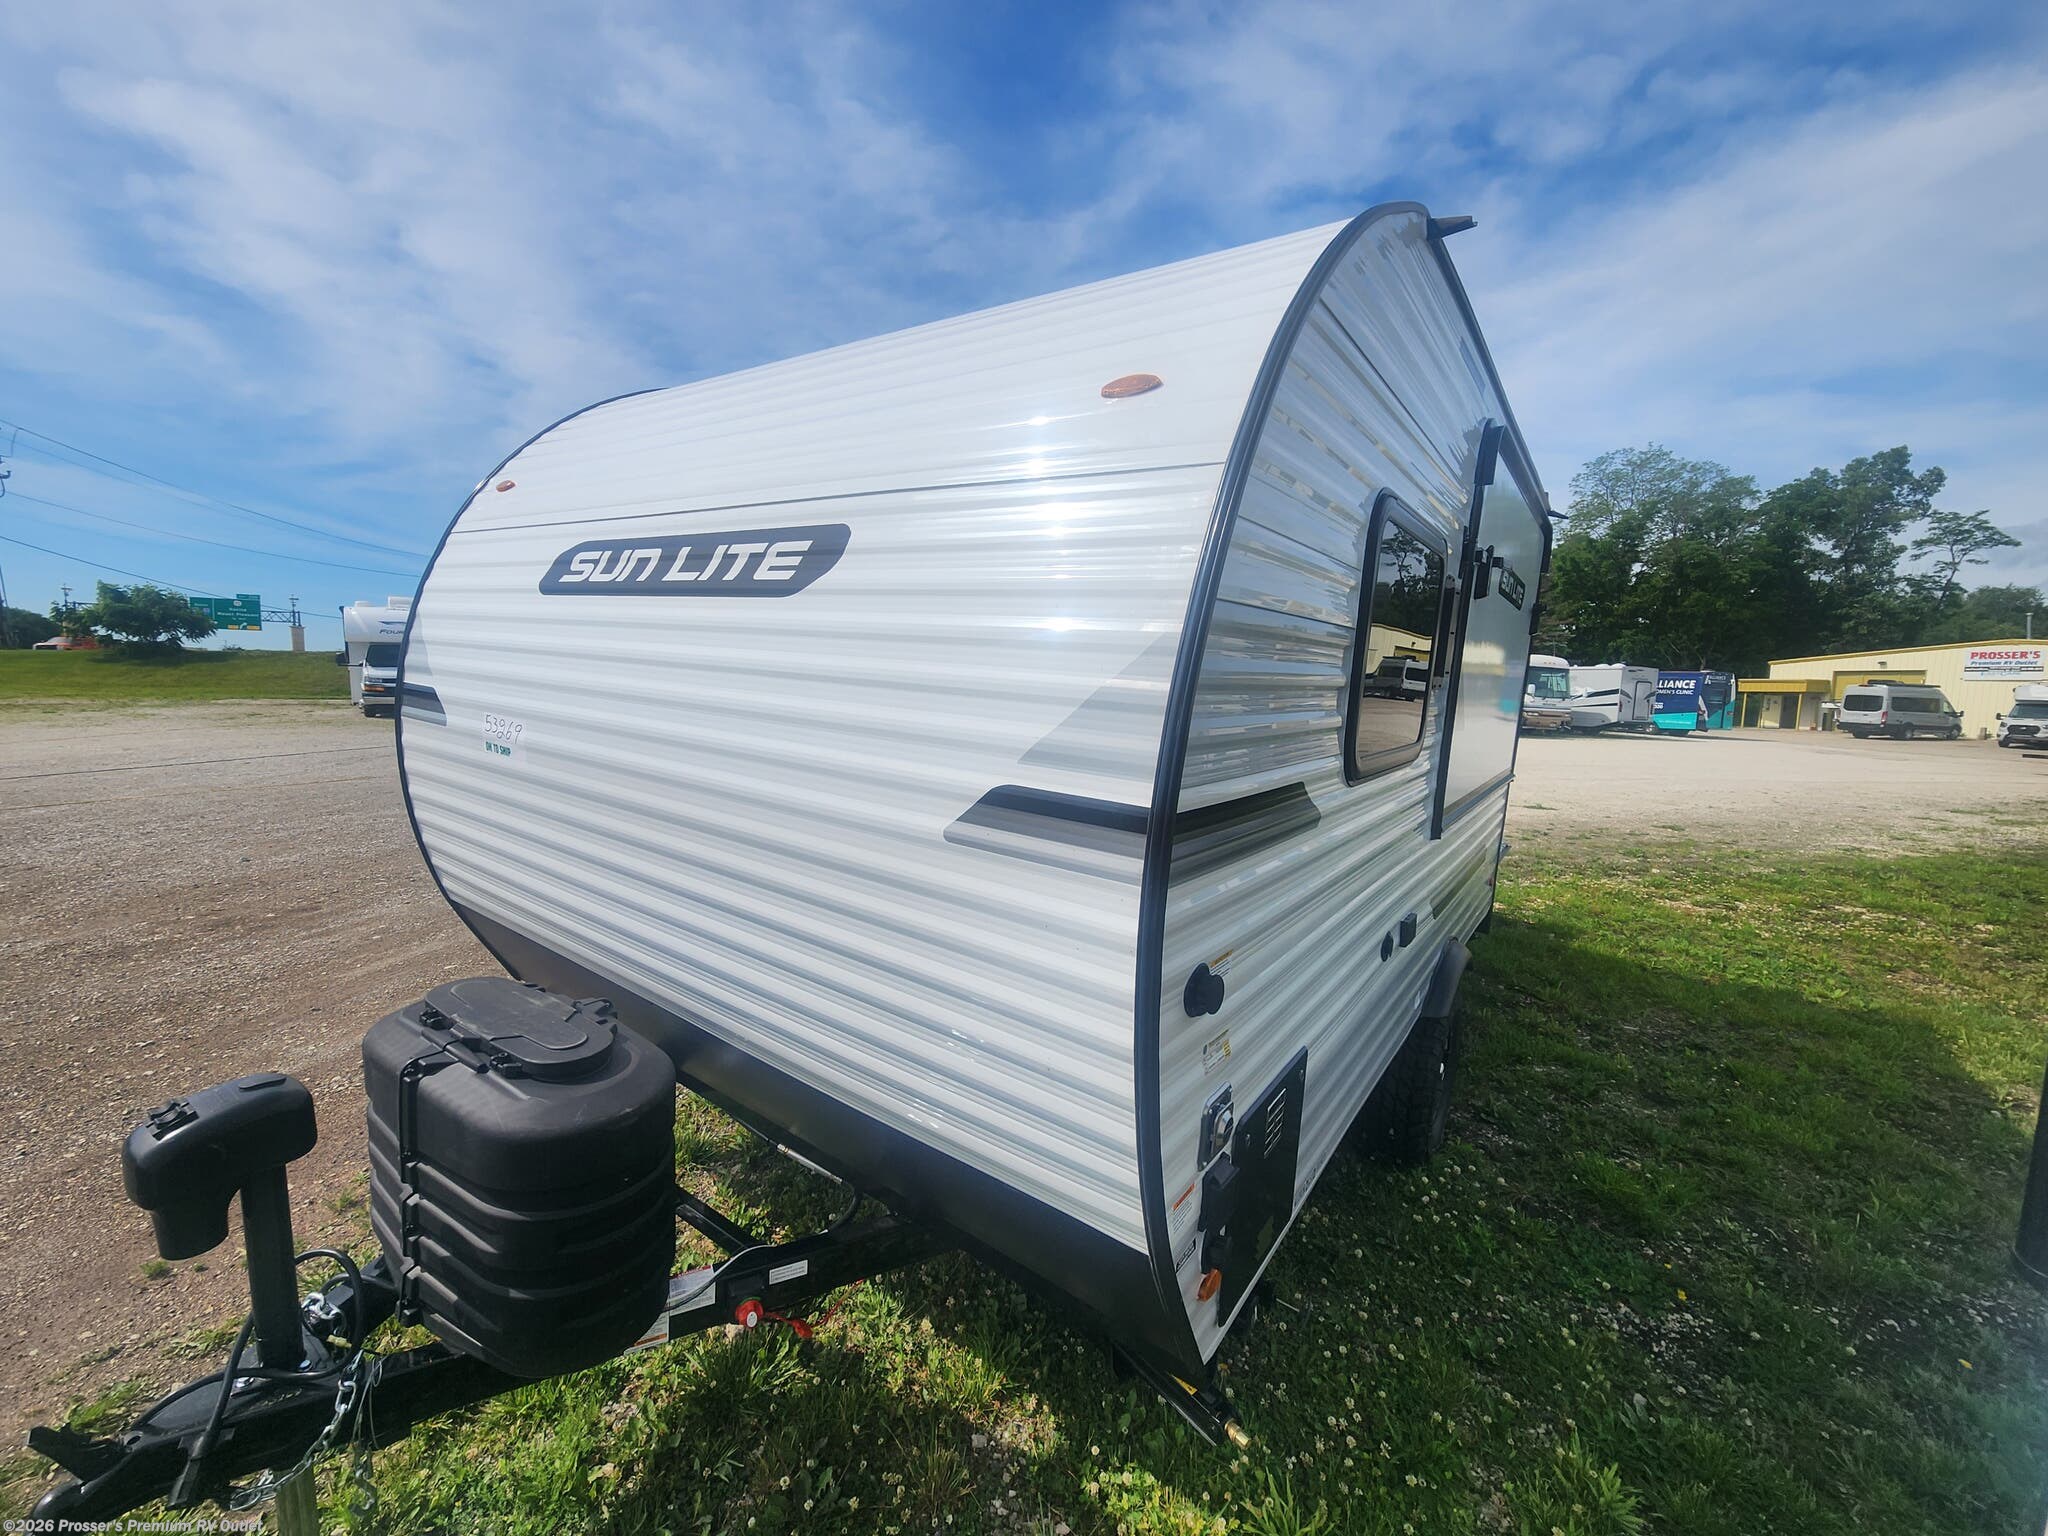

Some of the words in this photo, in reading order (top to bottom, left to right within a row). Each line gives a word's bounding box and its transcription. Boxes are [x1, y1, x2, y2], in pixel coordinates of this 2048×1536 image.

[559, 548, 662, 583] SUN
[662, 540, 813, 582] LITE
[1970, 650, 2041, 660] PROSSER'S
[1656, 680, 1696, 689] LIANCE
